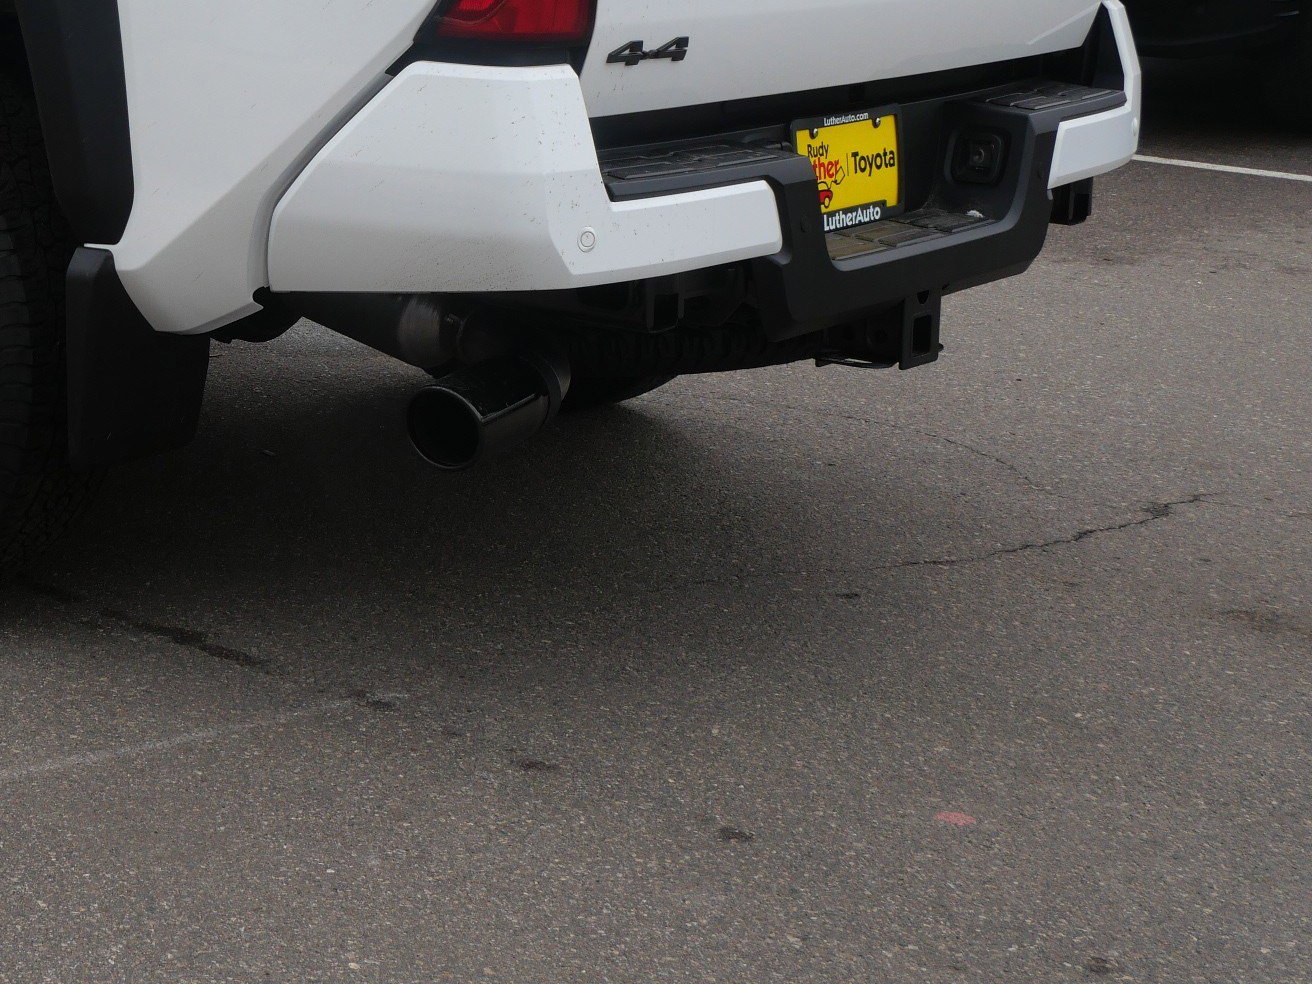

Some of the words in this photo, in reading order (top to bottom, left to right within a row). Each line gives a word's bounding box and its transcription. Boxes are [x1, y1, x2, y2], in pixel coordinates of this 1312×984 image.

[823, 112, 869, 127] LutherAuto.com
[807, 142, 829, 159] Rudy
[851, 147, 896, 177] Toyota
[812, 157, 840, 180] ther
[823, 205, 882, 231] LutherAuto
